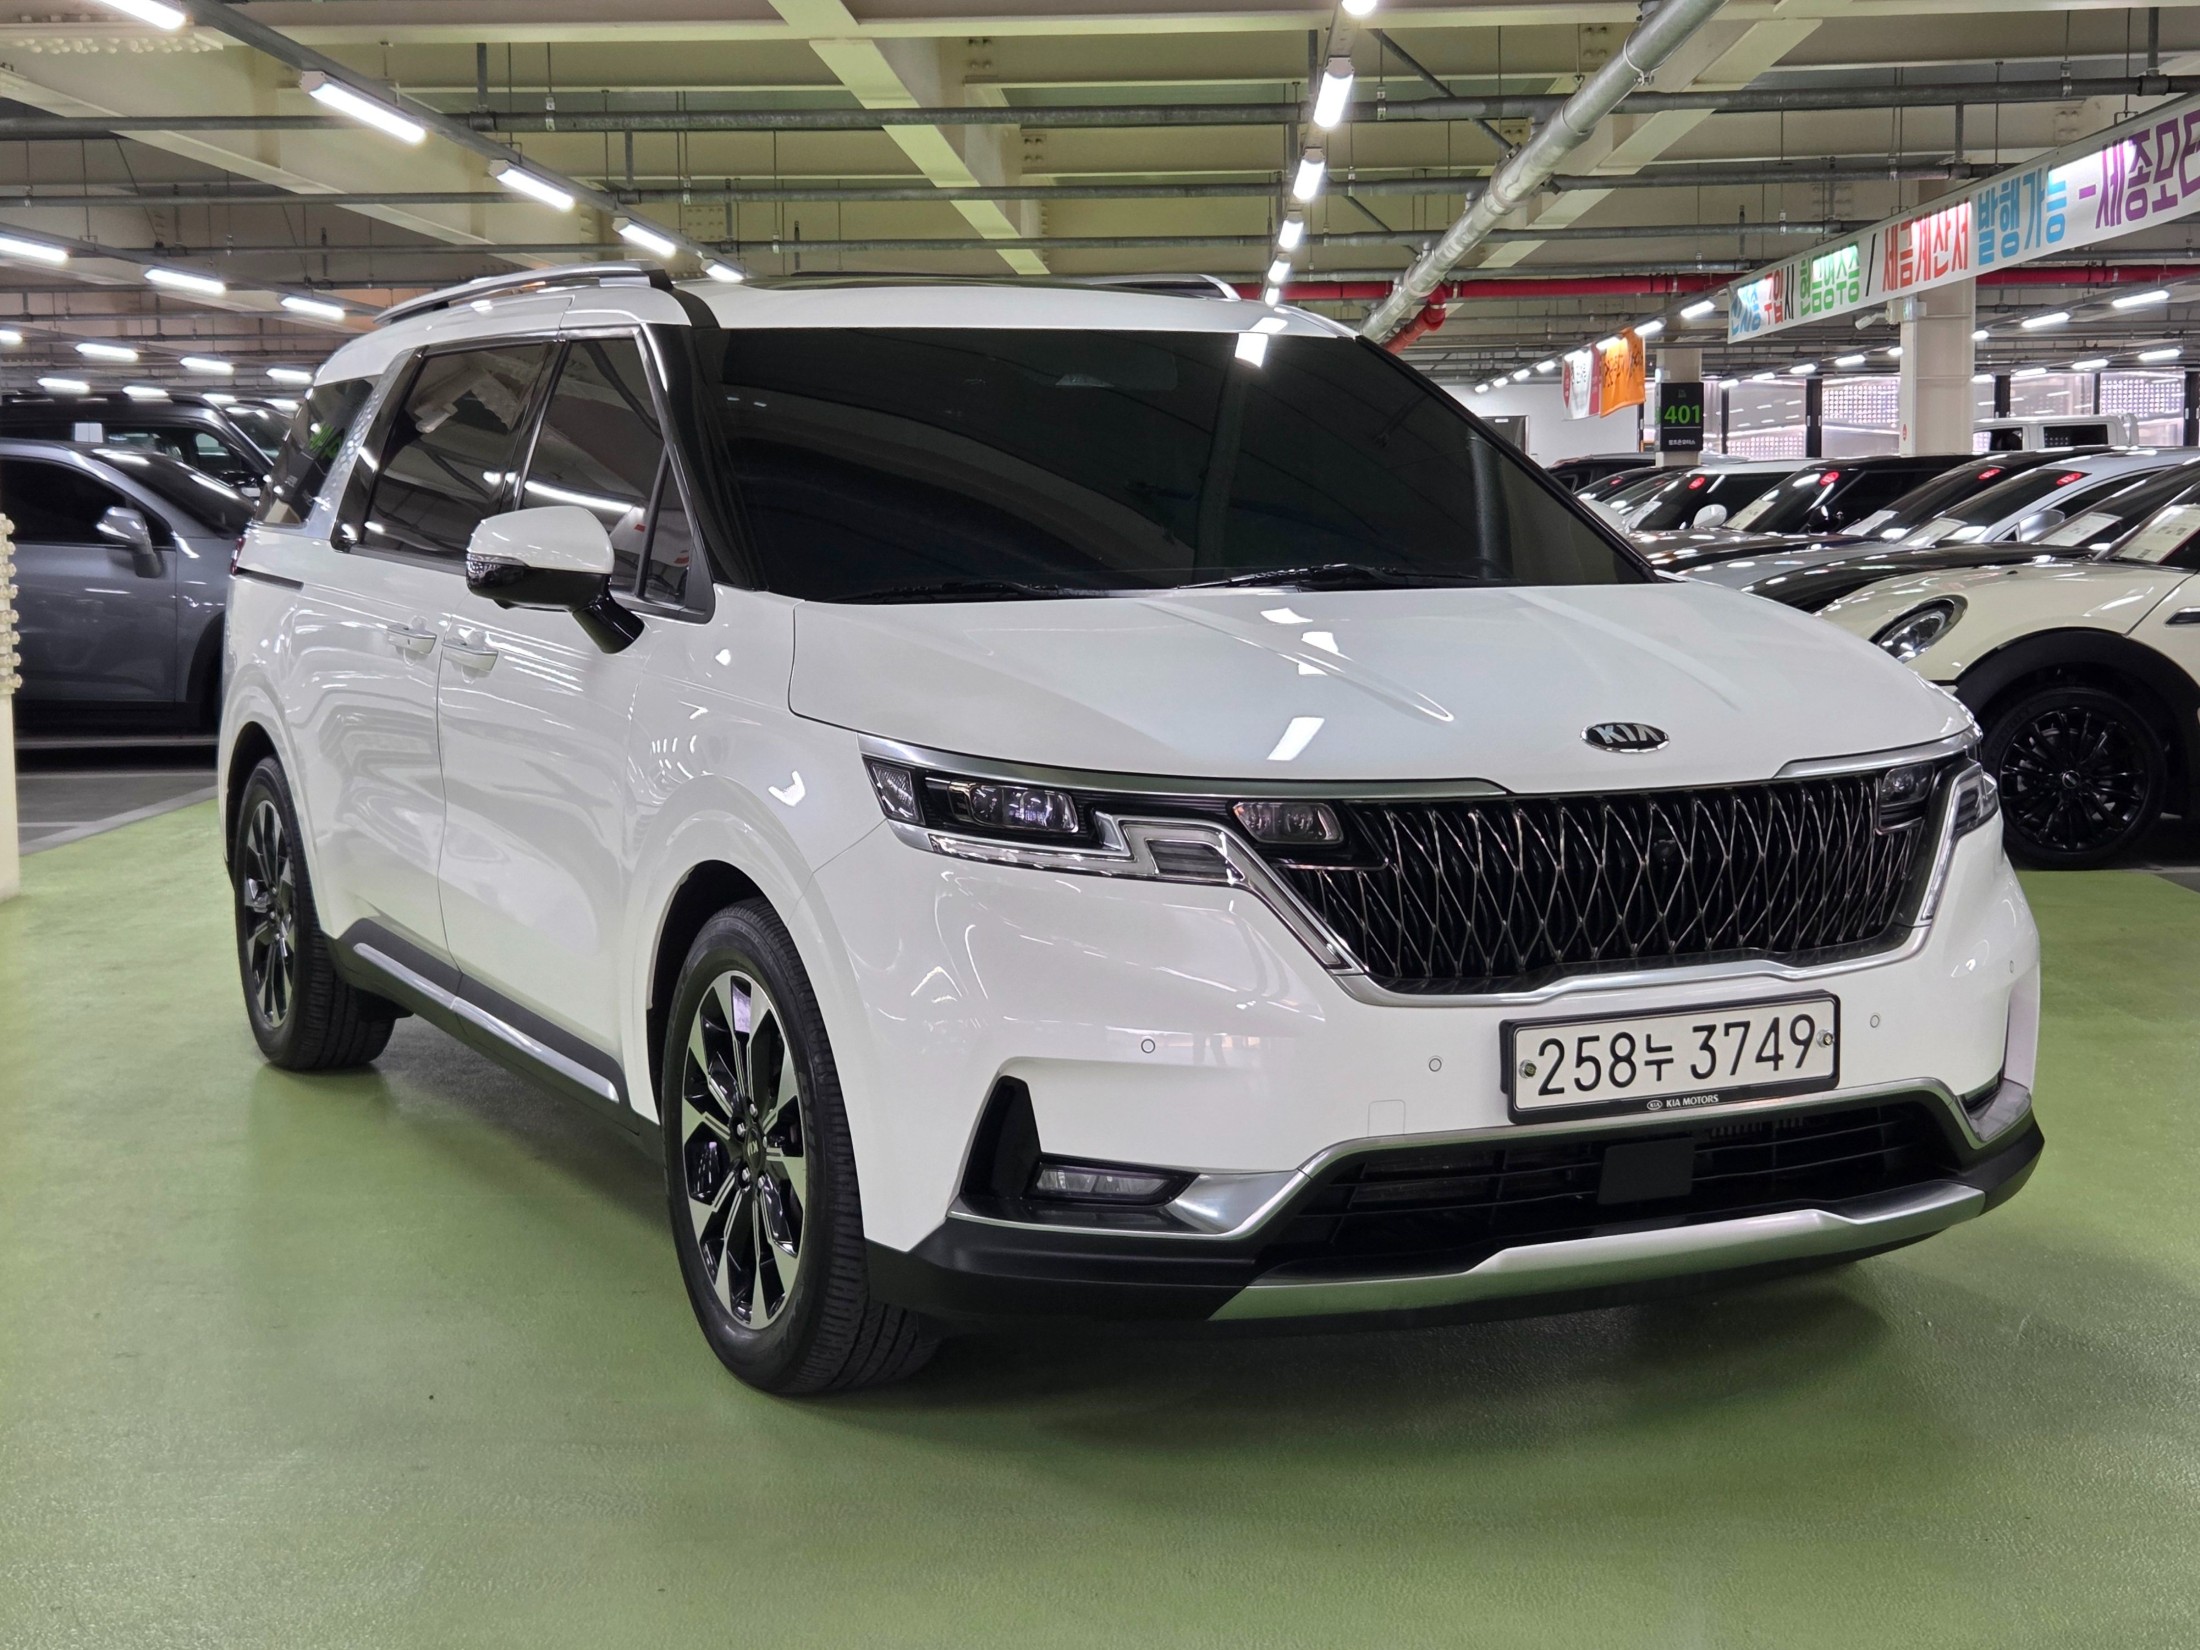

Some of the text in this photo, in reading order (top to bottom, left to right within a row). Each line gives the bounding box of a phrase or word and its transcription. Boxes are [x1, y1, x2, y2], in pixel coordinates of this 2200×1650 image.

[1800, 240, 1860, 317] 현금영수증
[1883, 196, 1970, 293] 세금계산서
[1977, 164, 2068, 266] 발행가능
[1664, 404, 1701, 424] 401
[1592, 724, 1662, 744] KIA
[1538, 1013, 1816, 1096] 258누 3749
[1666, 1099, 1681, 1108] KIA
[1682, 1094, 1719, 1106] MOTORS
